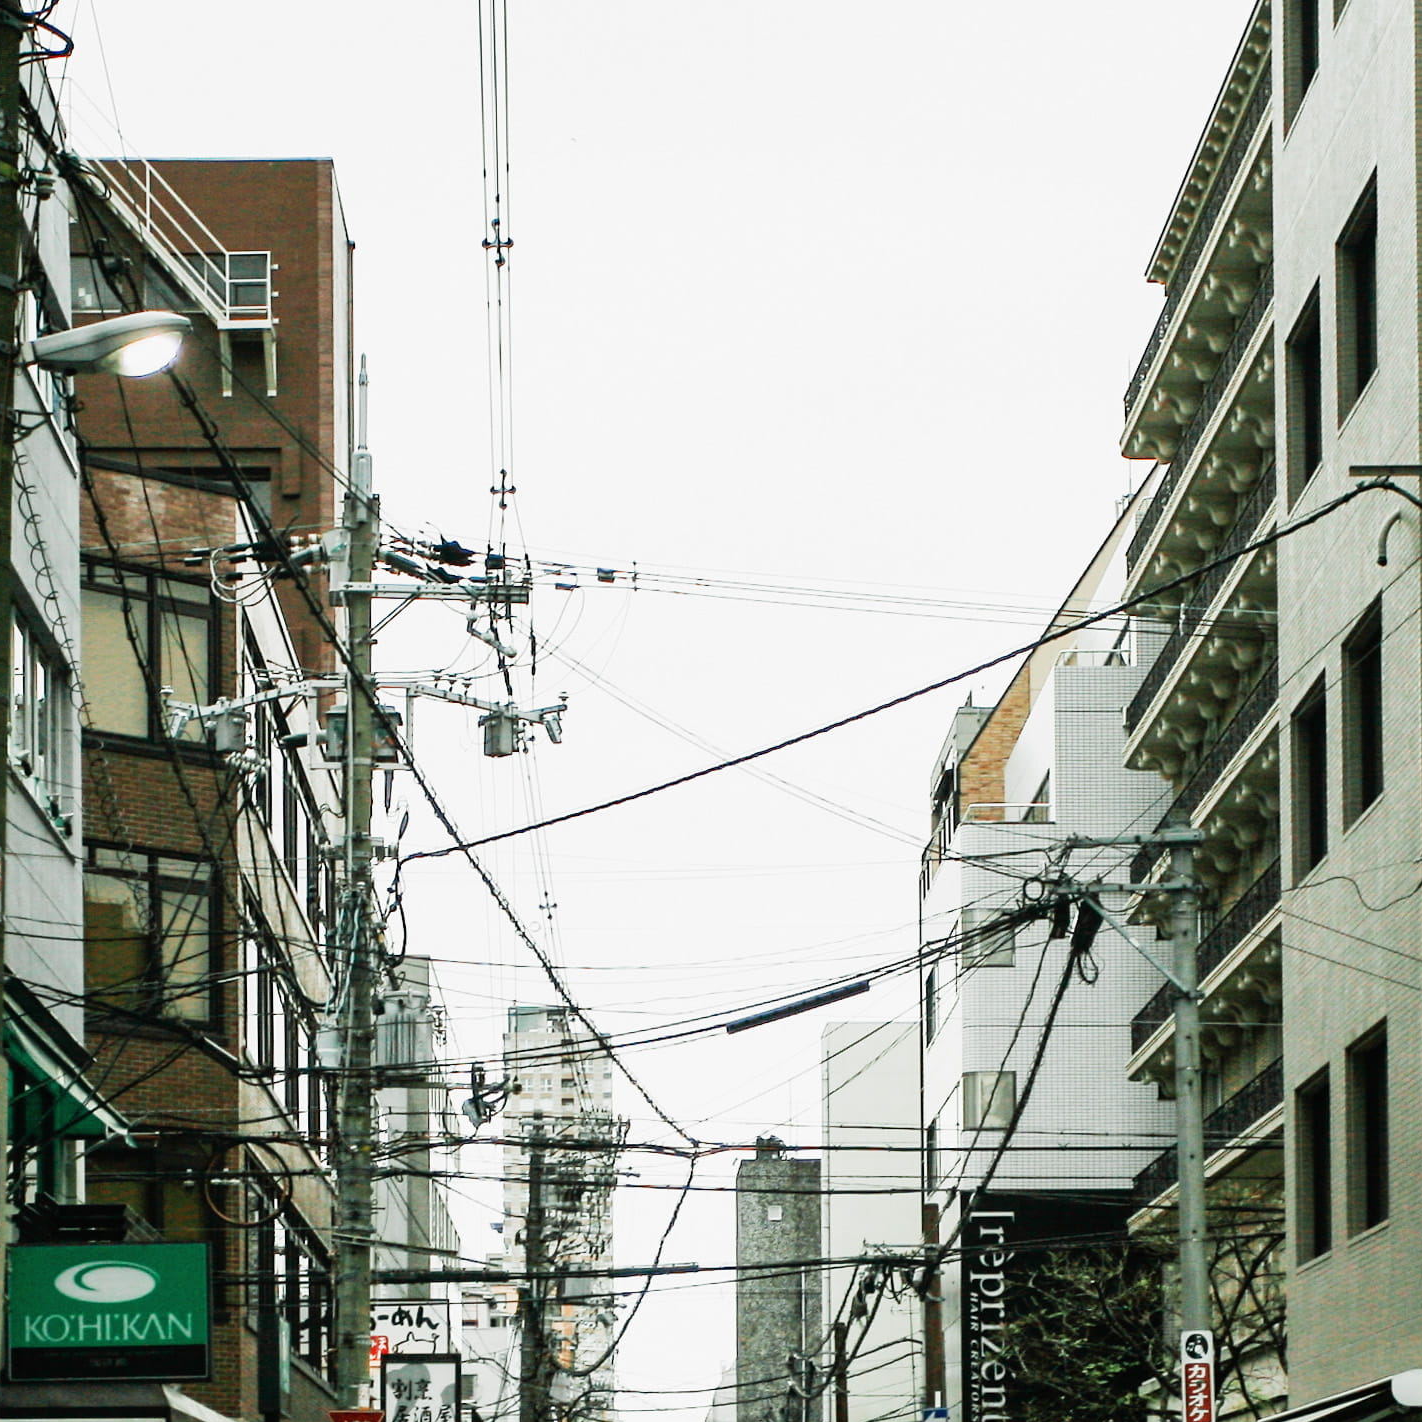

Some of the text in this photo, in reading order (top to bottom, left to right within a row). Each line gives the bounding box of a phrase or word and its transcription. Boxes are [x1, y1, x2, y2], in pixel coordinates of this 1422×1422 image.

[969, 1292, 980, 1422] HAIR CREATORS
[391, 1378, 432, 1401] 割烹
[1187, 1366, 1211, 1422] カラオケ
